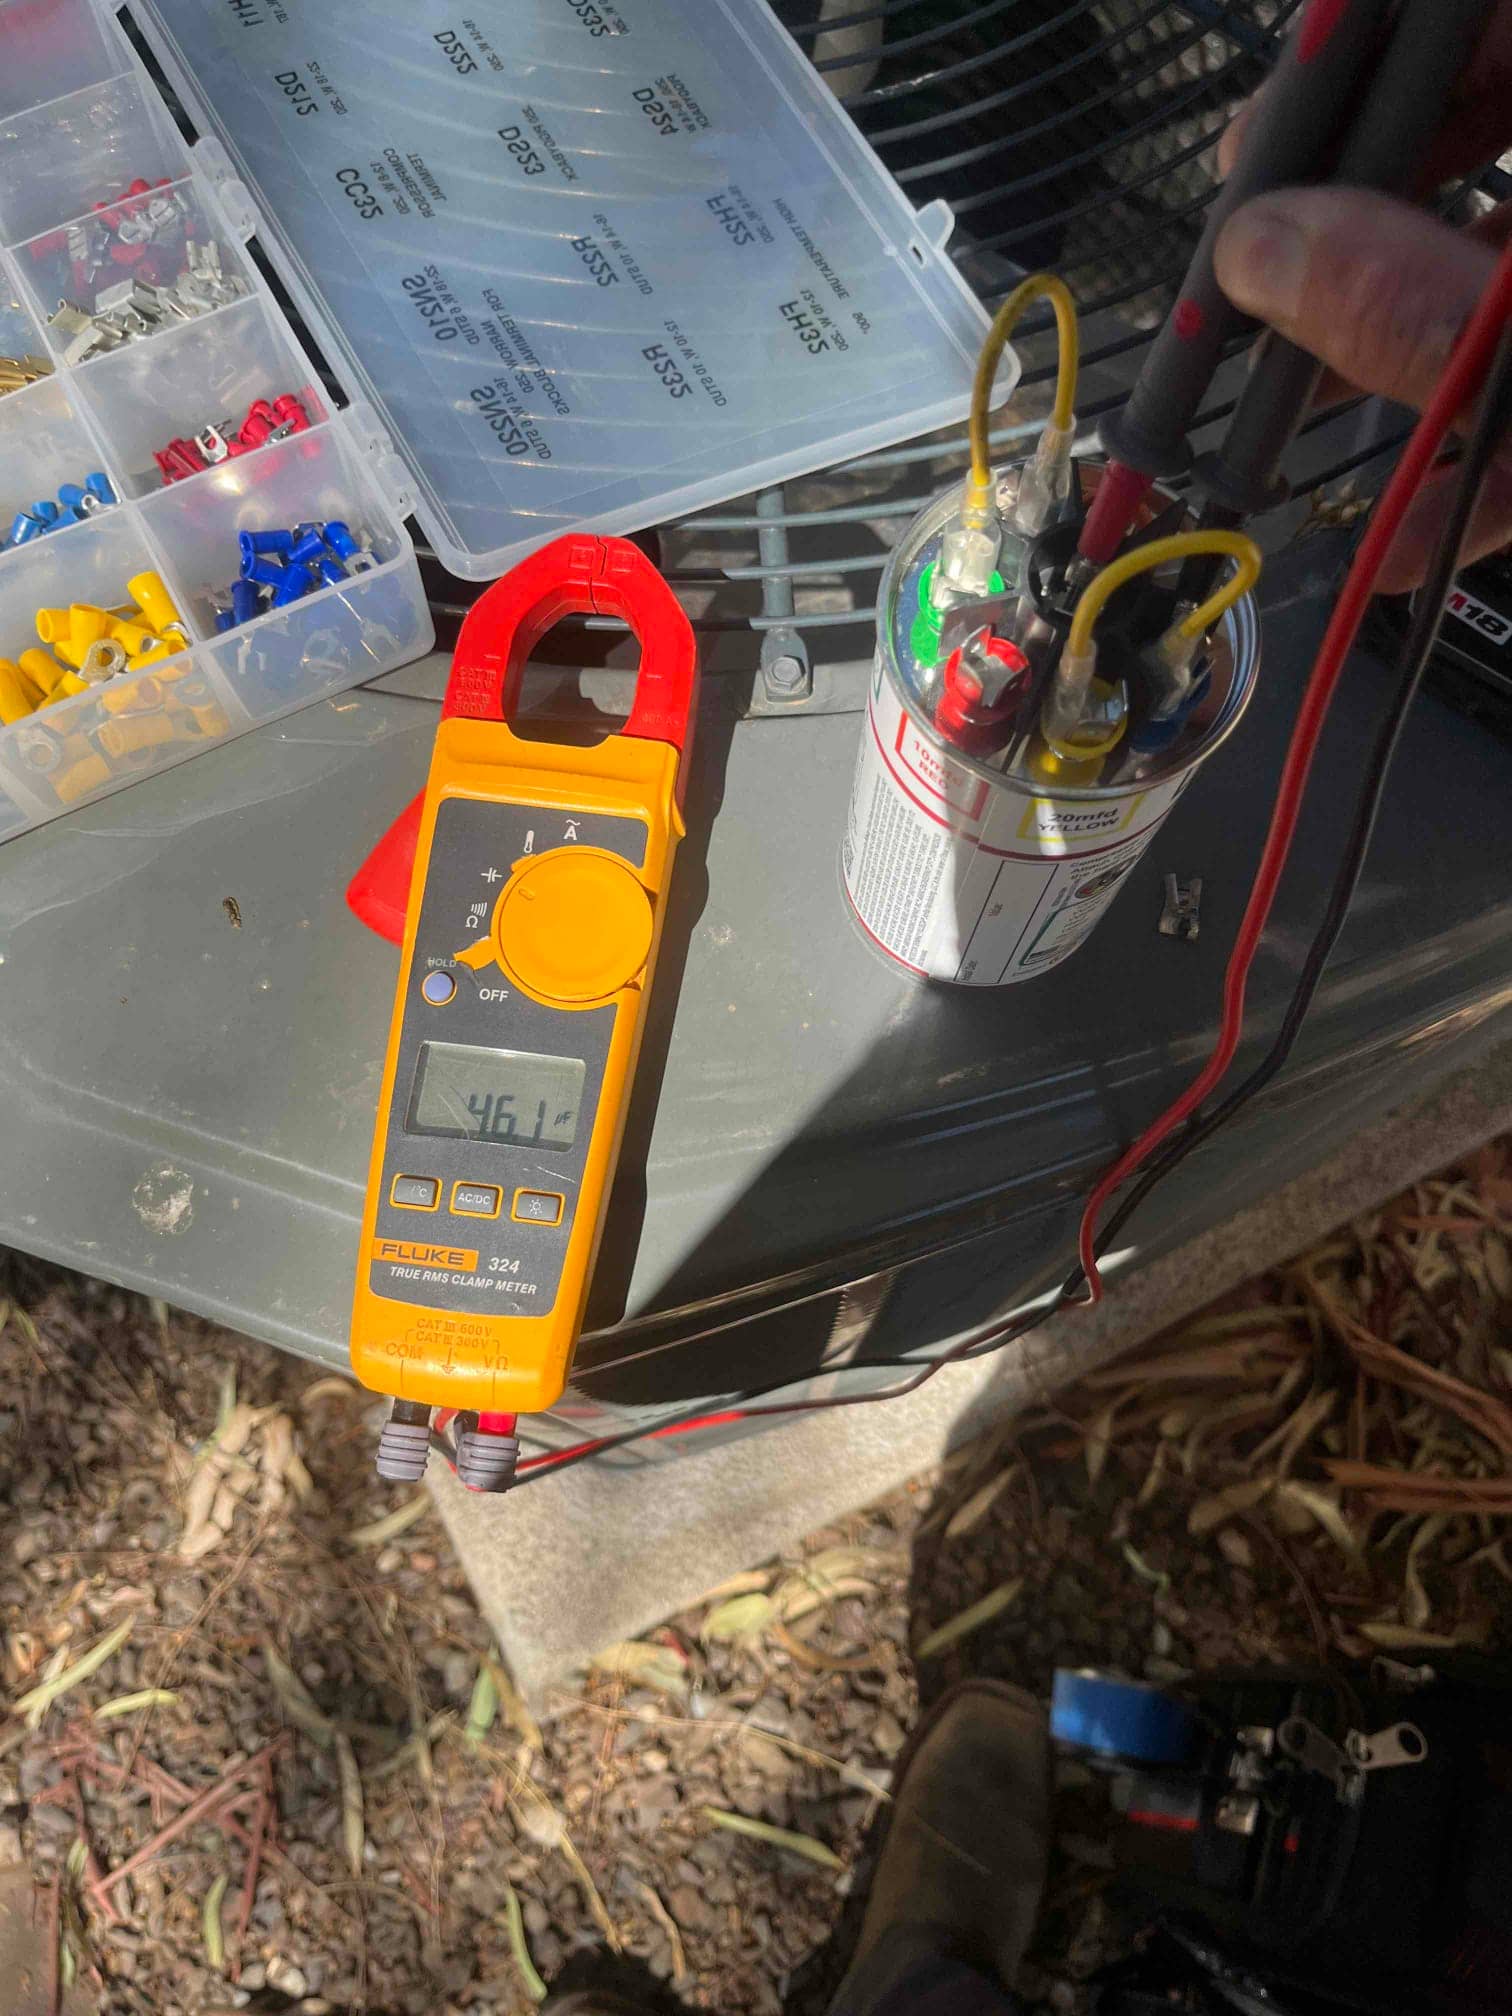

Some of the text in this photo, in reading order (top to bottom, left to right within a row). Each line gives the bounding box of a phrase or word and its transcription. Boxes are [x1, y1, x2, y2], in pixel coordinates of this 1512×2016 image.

[1047, 807, 1119, 822] 20mfd
[1038, 816, 1120, 832] YELLOW
[427, 956, 458, 969] HOLD
[478, 988, 510, 1002] OFF
[457, 1191, 492, 1206] AC/DC
[381, 1242, 466, 1266] FLUKE
[487, 1256, 521, 1274] 324
[389, 1265, 538, 1296] TRUE RMS CLAMP METER
[416, 1317, 443, 1331] CAT
[415, 1330, 442, 1343] CAT
[385, 1341, 424, 1361] COM
